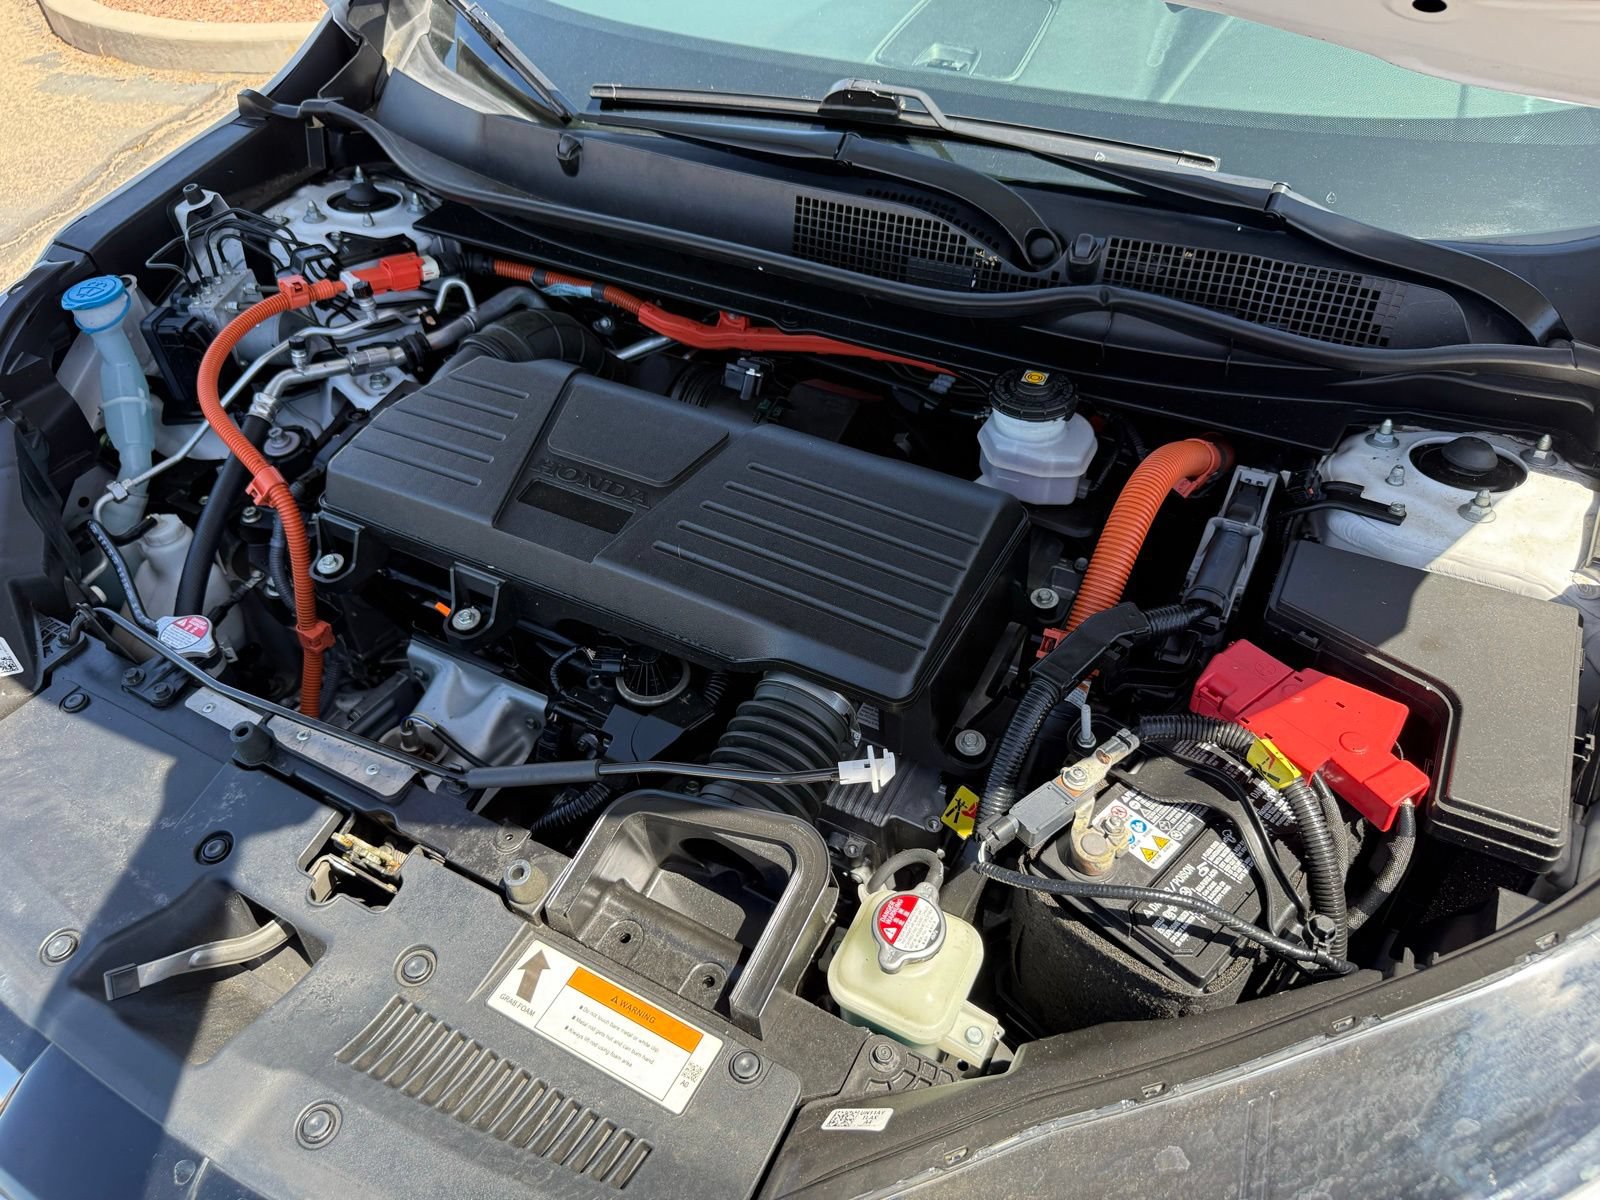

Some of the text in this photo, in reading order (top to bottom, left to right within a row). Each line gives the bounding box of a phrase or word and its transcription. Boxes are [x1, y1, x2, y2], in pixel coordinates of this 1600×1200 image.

[529, 460, 650, 510] HONDA
[500, 993, 536, 1017] GRAB FOAM
[620, 1000, 656, 1024] WARNING
[590, 1011, 598, 1019] not
[598, 1015, 610, 1025] touch
[621, 1028, 633, 1038] metal
[576, 1017, 588, 1027] Metal
[588, 1023, 596, 1032] rod
[595, 1028, 605, 1038] gets
[613, 1039, 623, 1047] and
[631, 1048, 642, 1058] burn
[641, 1054, 655, 1065] hand
[598, 1045, 610, 1056] using
